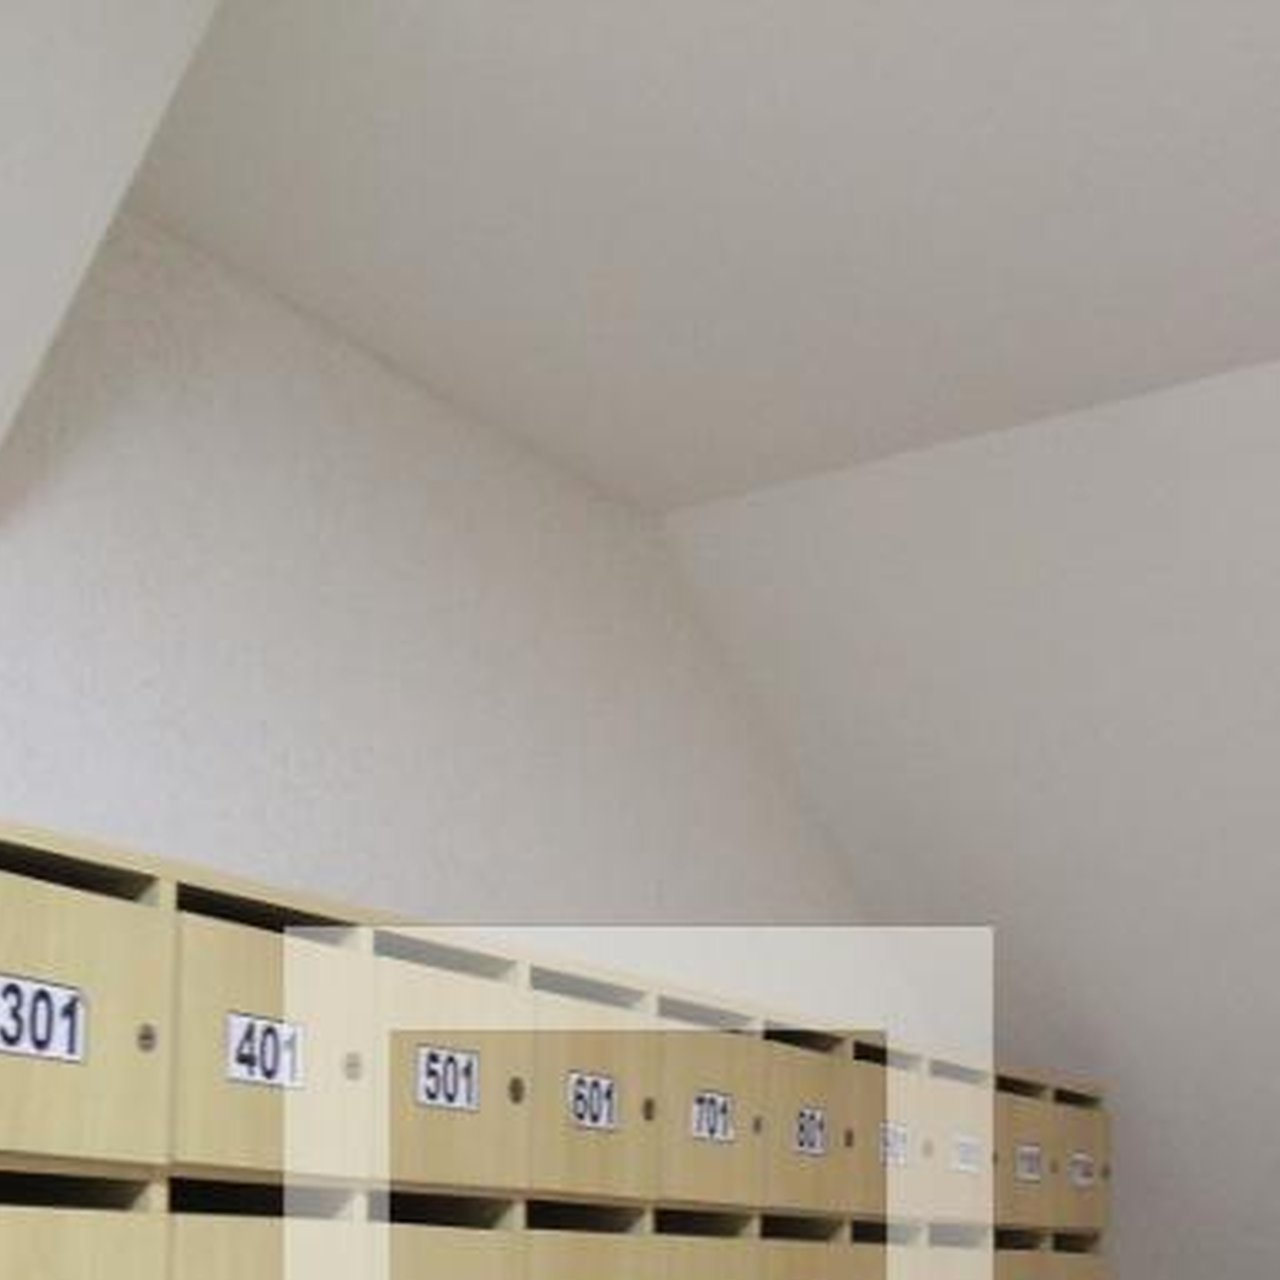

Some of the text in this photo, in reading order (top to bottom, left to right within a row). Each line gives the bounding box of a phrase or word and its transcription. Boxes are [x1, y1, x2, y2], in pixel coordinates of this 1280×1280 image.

[0, 982, 82, 1054] 301
[235, 1022, 299, 1082] 401
[424, 1052, 475, 1104] 501
[573, 1078, 615, 1123] 601
